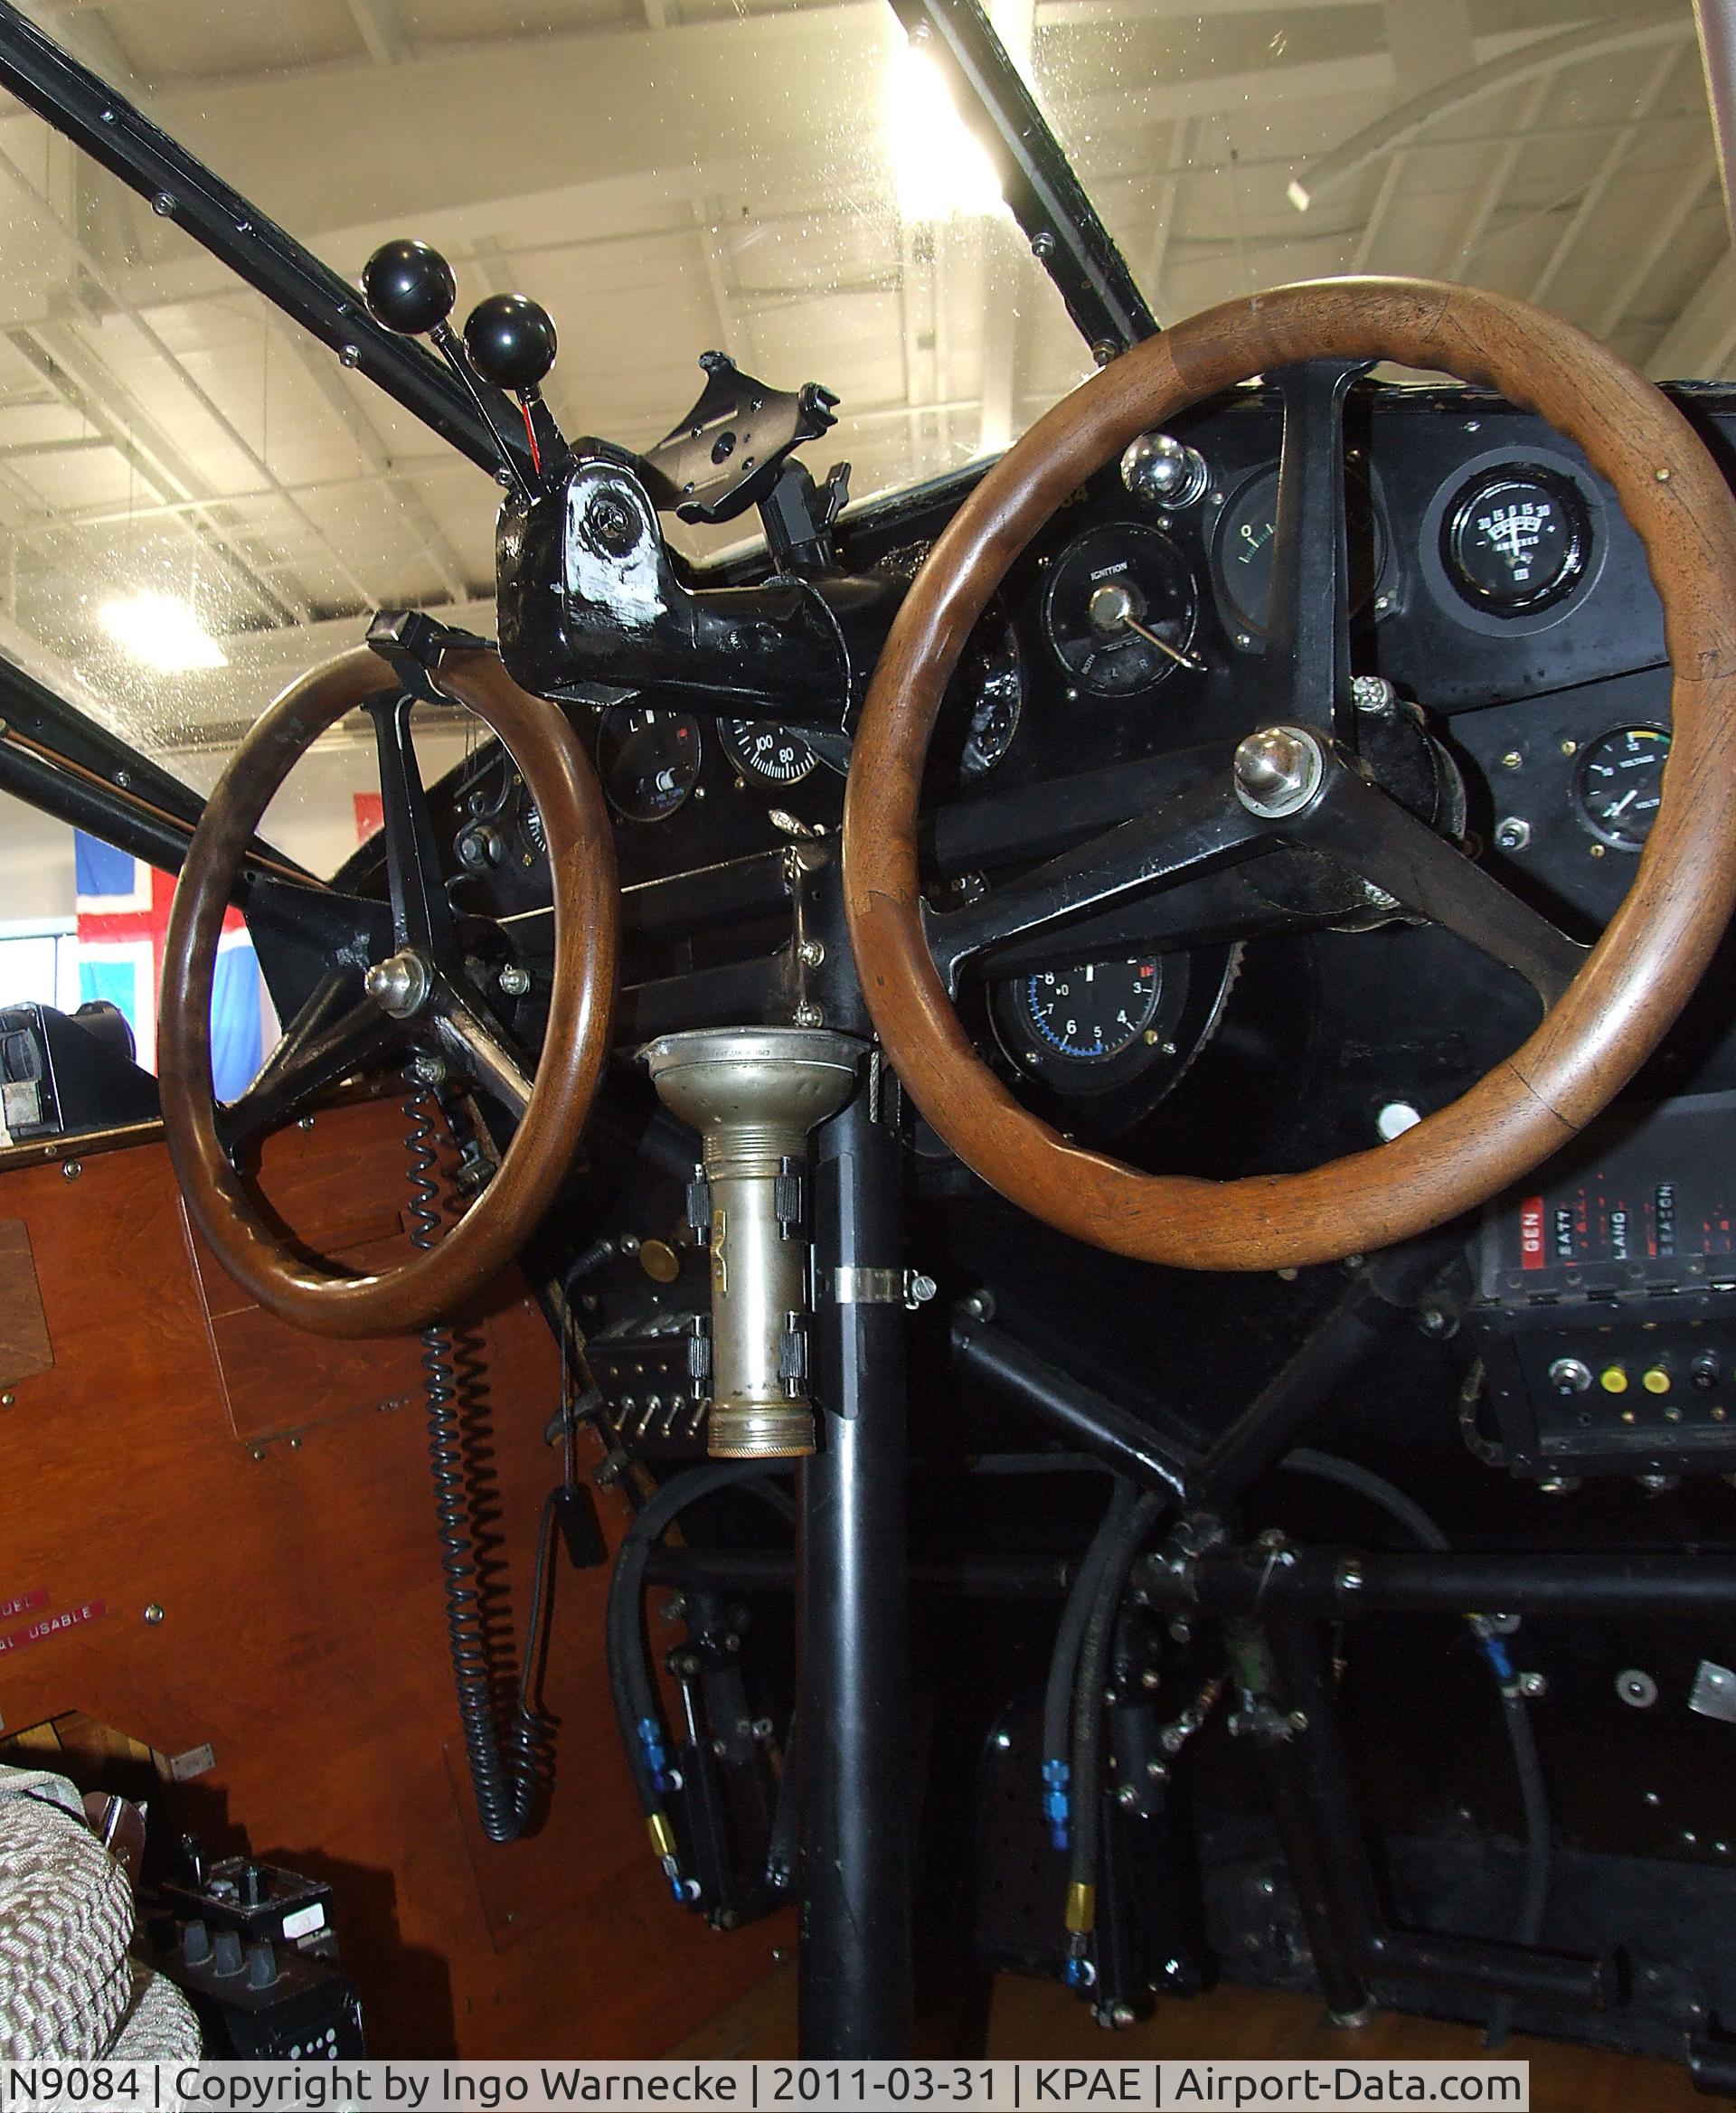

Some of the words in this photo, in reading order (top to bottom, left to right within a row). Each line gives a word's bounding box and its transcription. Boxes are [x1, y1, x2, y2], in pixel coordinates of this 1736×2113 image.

[1477, 517, 1492, 531] 30
[1493, 509, 1505, 522] 15
[1521, 503, 1533, 515] 15
[1535, 505, 1551, 517] 30
[1090, 561, 1128, 581] IGNITION
[1080, 653, 1097, 675] BOTH
[1138, 658, 1149, 669] R
[756, 734, 774, 752] 100
[778, 748, 794, 763] 80
[1044, 971, 1055, 986] 8
[1133, 981, 1142, 994] 3
[1046, 1003, 1054, 1015] 7
[1117, 1009, 1127, 1024] 4
[1066, 1019, 1078, 1034] 6
[1093, 1025, 1102, 1038] 5
[1523, 1212, 1541, 1252] GEN
[1610, 1211, 1628, 1260] LAND
[29, 1606, 91, 1639] USABLE
